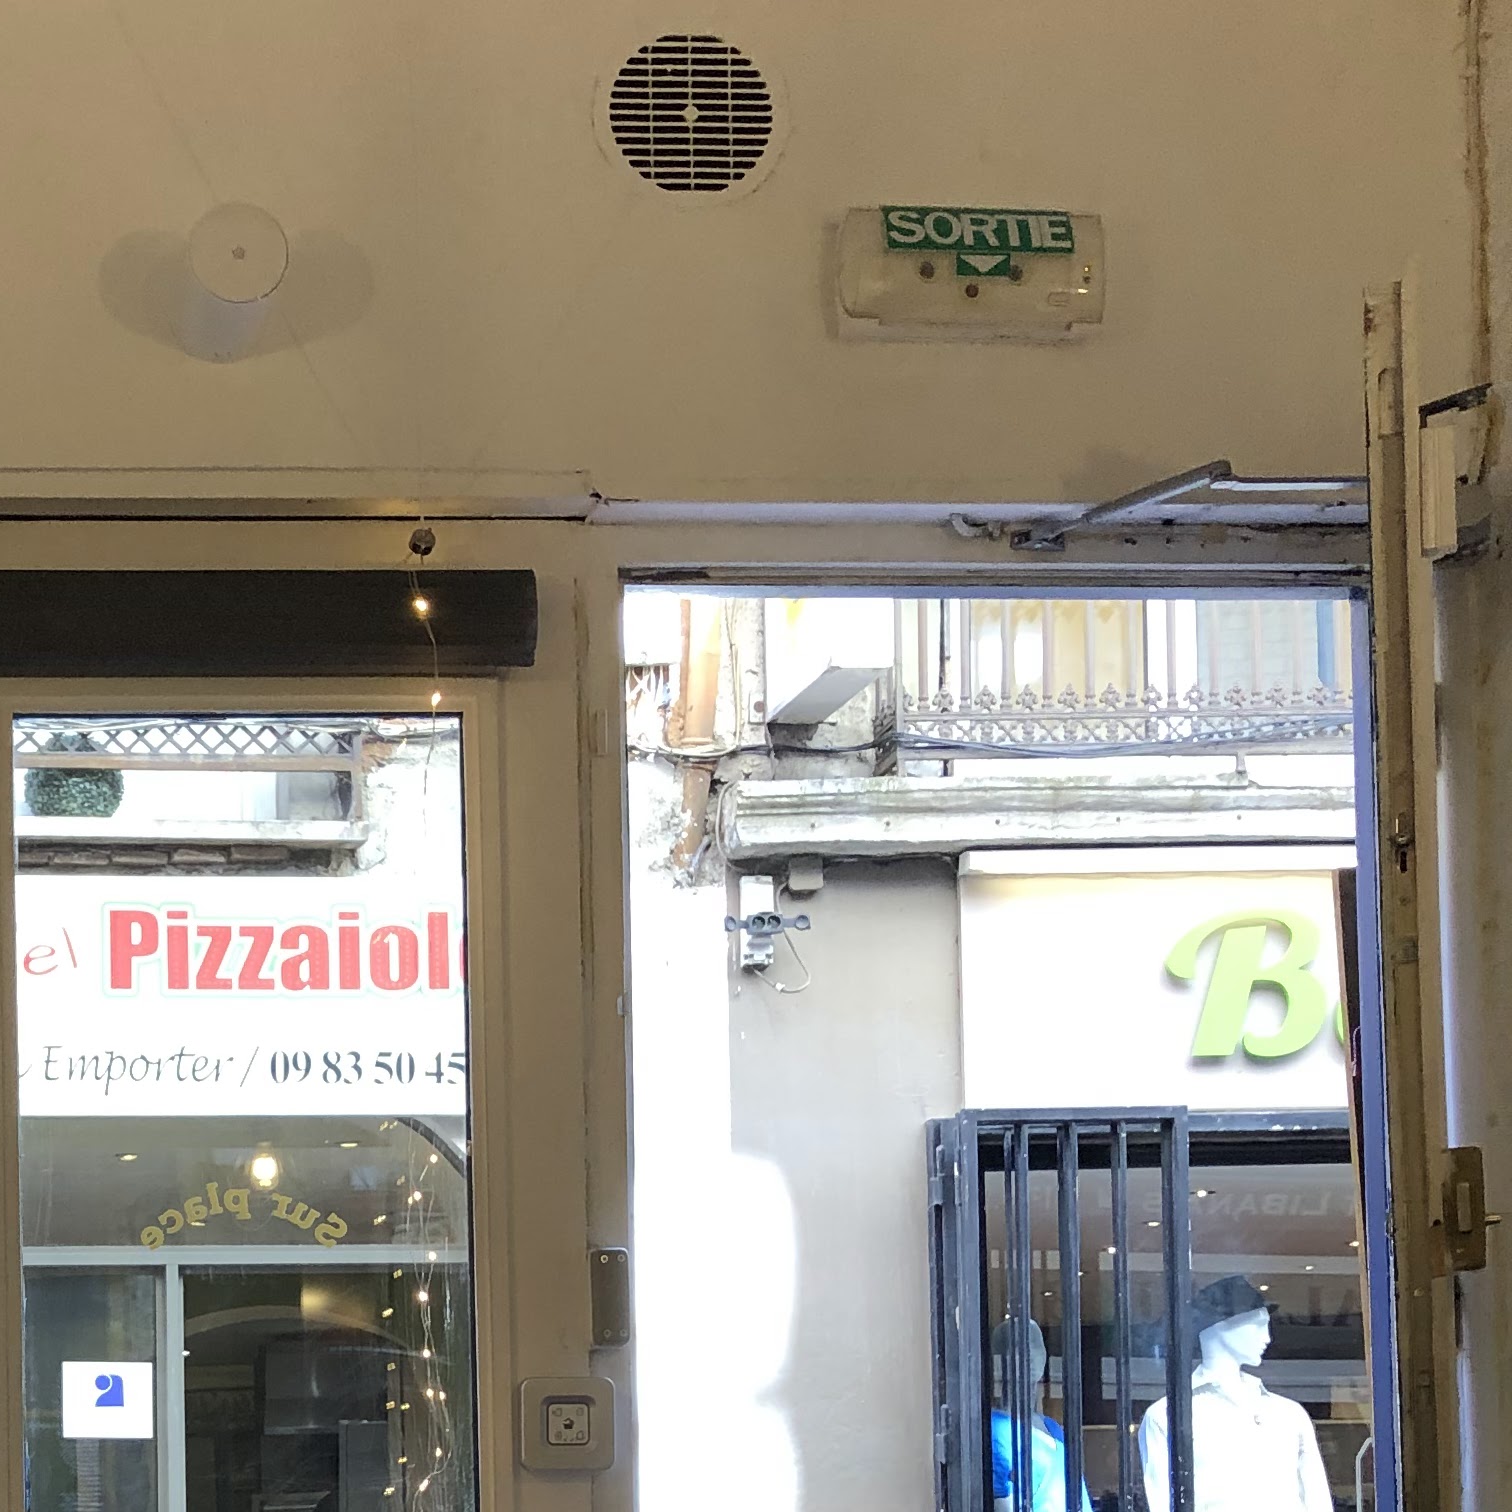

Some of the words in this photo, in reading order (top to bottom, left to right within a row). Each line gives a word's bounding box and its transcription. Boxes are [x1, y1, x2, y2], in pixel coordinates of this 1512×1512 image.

[888, 210, 1072, 249] SORTIE
[1164, 908, 1346, 1059] B
[270, 1050, 312, 1084] 09
[322, 1051, 363, 1085] 83
[374, 1051, 416, 1085] 50
